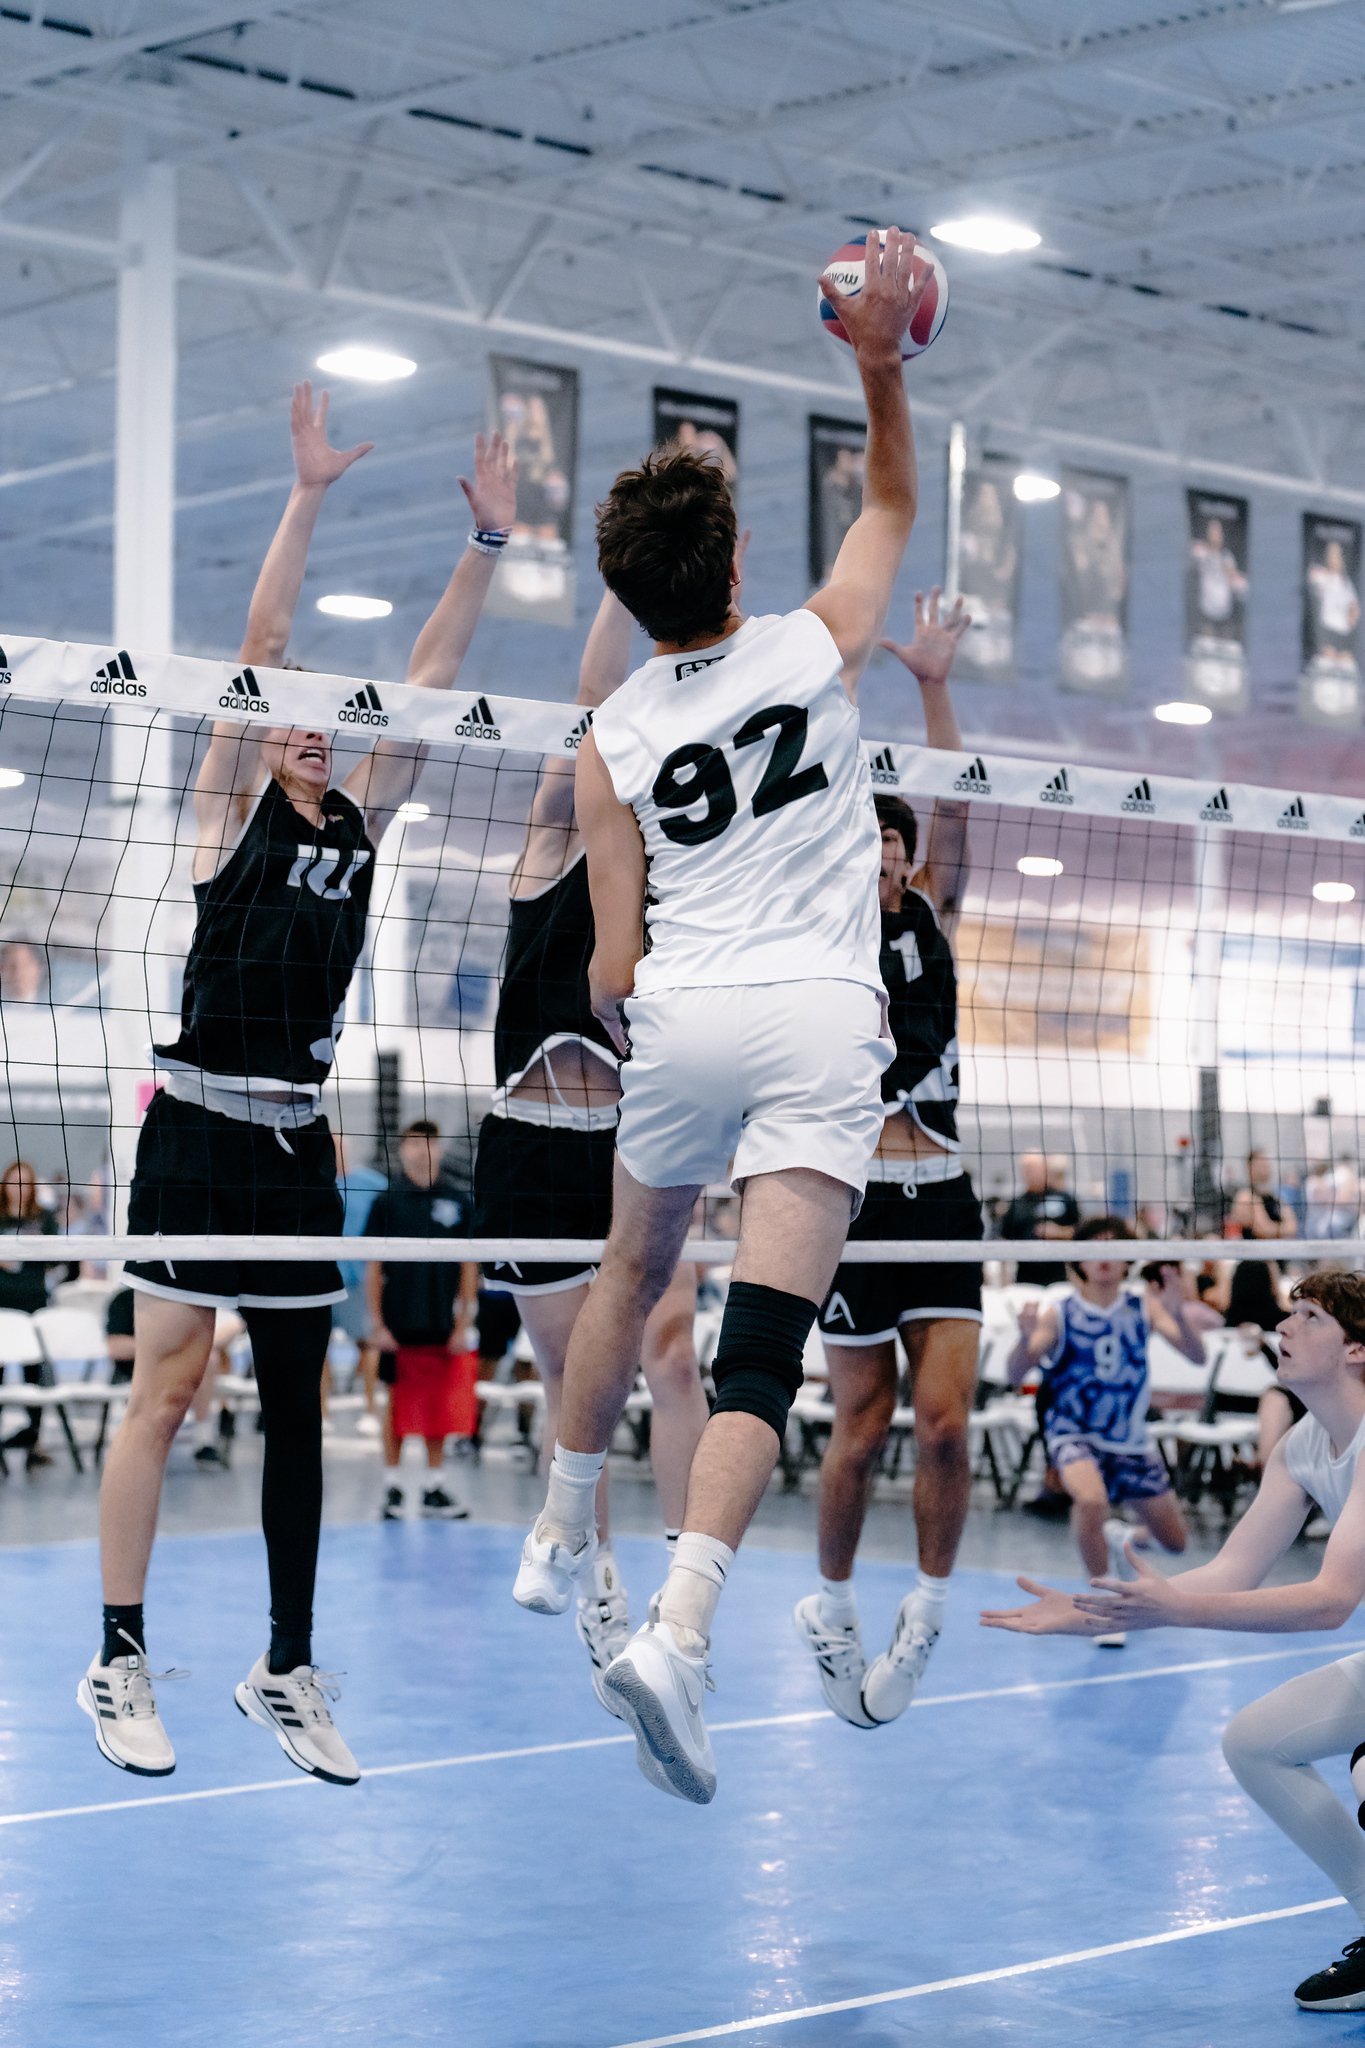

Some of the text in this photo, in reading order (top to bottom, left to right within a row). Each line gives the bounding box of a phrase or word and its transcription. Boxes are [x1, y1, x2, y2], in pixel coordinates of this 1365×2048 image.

[90, 678, 147, 697] adidas
[219, 694, 270, 713] adidas
[338, 708, 389, 727] adidas
[455, 722, 501, 741] adidas
[652, 704, 828, 846] 92
[871, 770, 900, 785] didas
[954, 779, 991, 795] adidas
[1040, 790, 1074, 805] adidas
[1121, 801, 1155, 814] adidas
[1200, 810, 1233, 823] adidas
[1277, 818, 1308, 831] adidas
